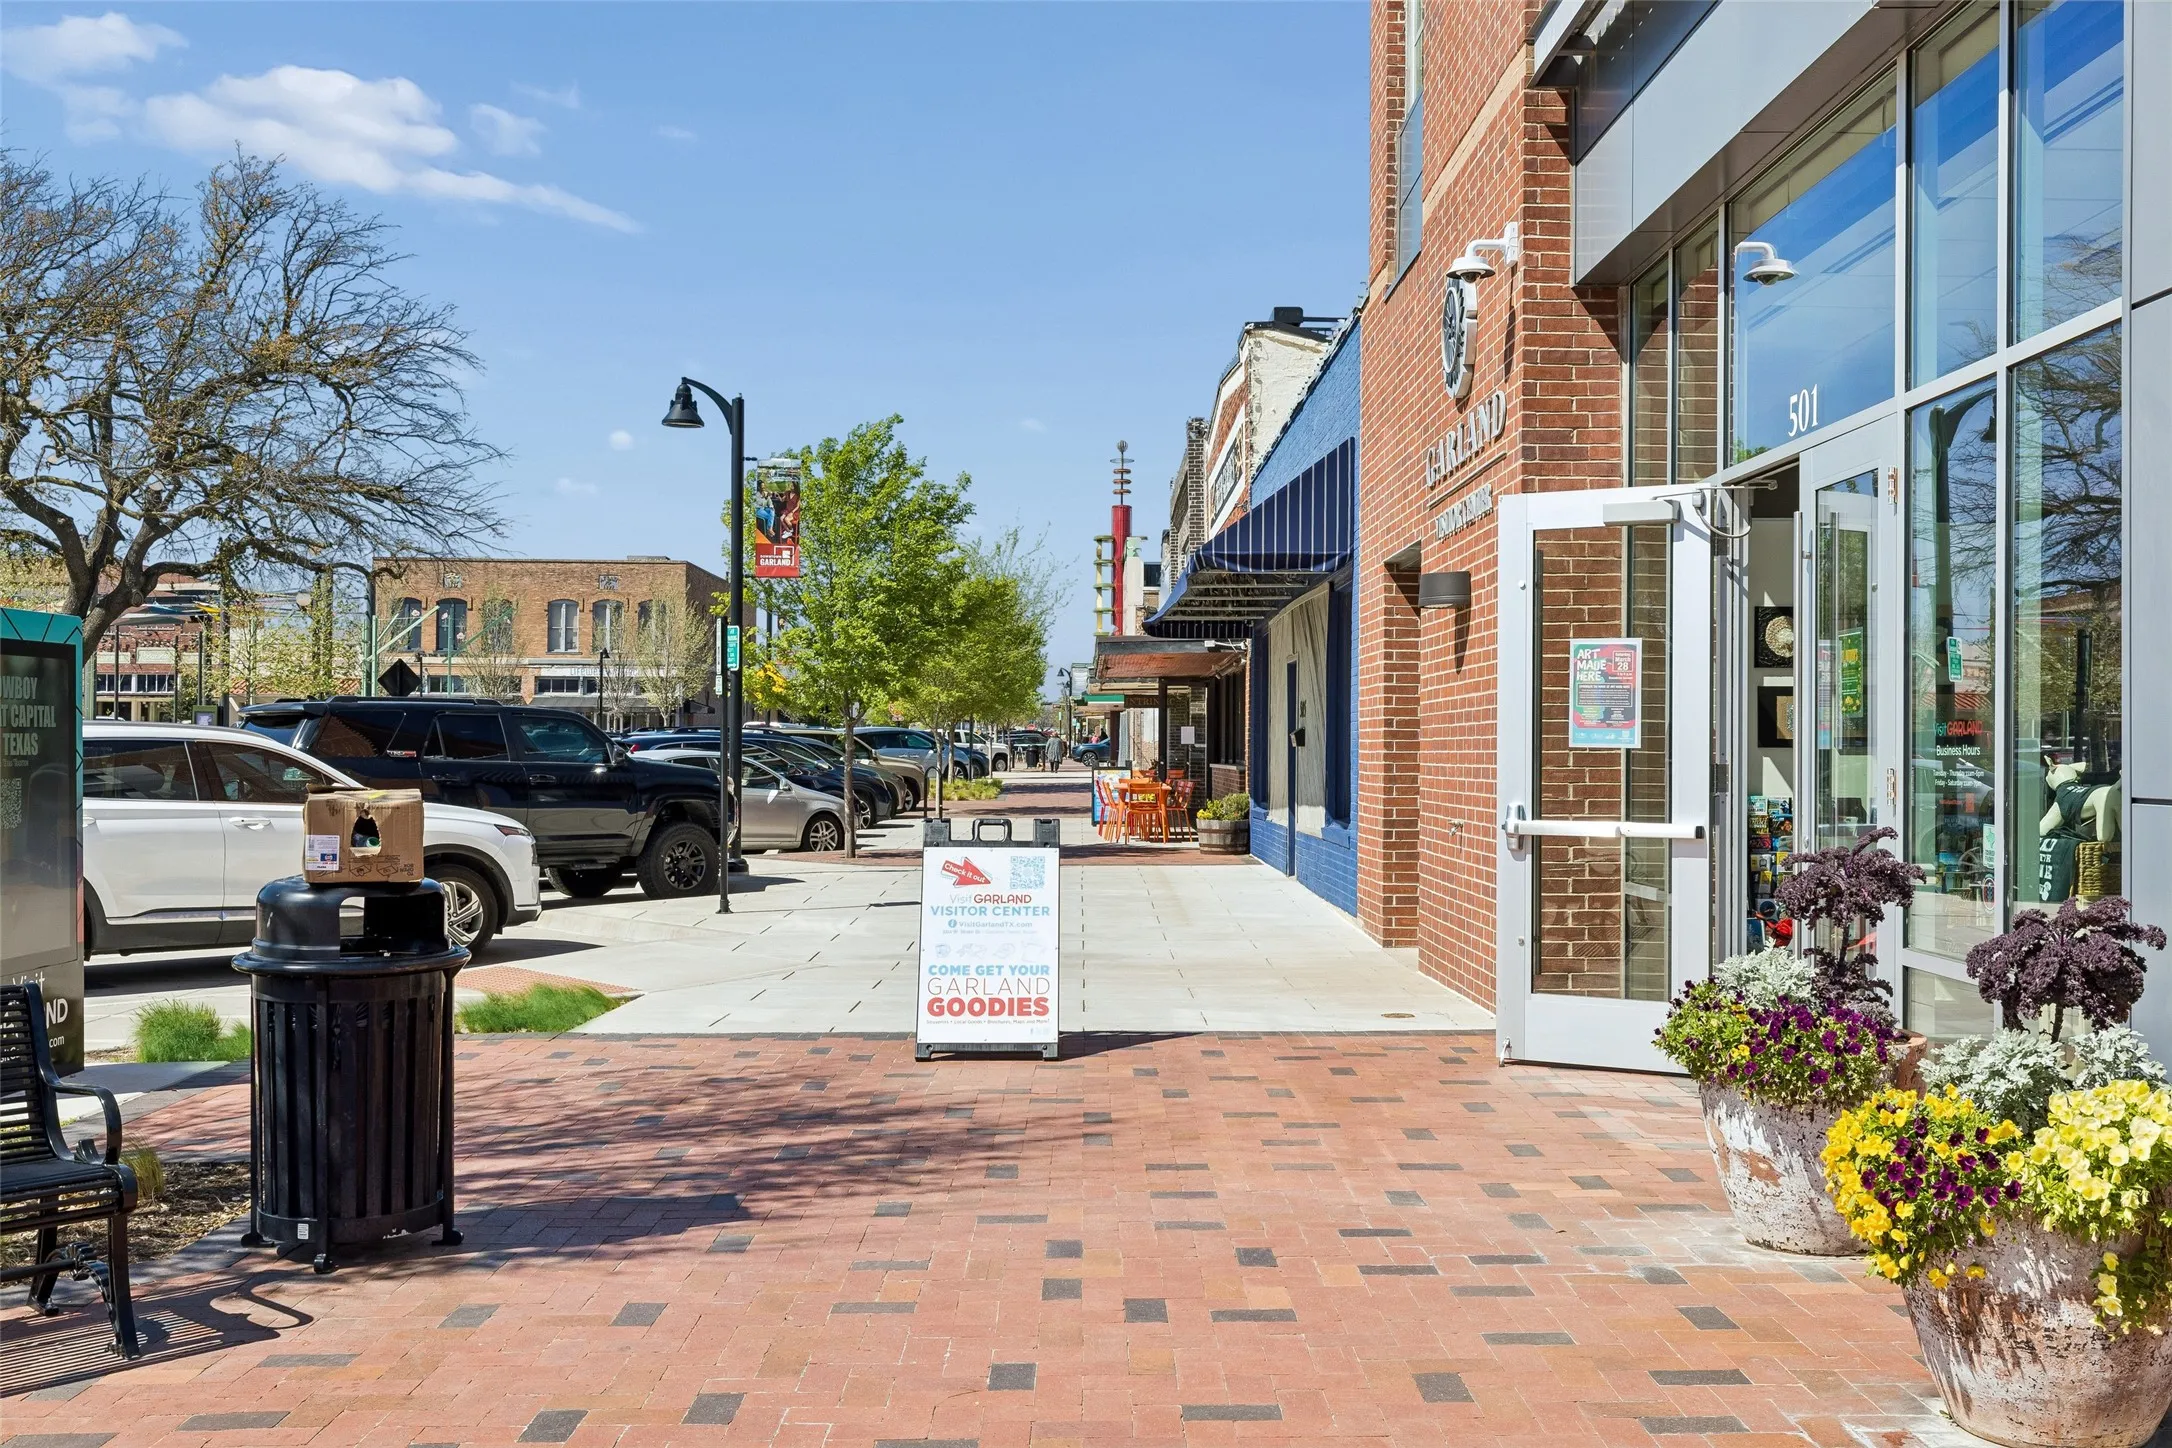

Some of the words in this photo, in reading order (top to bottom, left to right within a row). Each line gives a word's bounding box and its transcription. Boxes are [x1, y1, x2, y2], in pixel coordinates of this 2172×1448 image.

[1788, 383, 1818, 437] 501
[1426, 390, 1507, 487] GARLAND
[760, 558, 791, 566] GARLAND
[1577, 648, 1600, 660] ART
[1576, 660, 1606, 671] MADE
[1617, 662, 1629, 671] 28
[1576, 671, 1602, 681] HERE
[0, 675, 38, 700] WBOY
[11, 704, 56, 728] CAPITAL
[1933, 722, 1946, 736] Visit
[1947, 720, 1983, 736] GARLAND
[3, 733, 39, 756] TEXAS
[1936, 744, 1962, 756] Business
[1962, 744, 1981, 756] Hours
[1935, 779, 1946, 787] Friday
[944, 863, 966, 875] Check
[966, 870, 973, 878] it
[973, 874, 985, 883] out
[949, 893, 972, 904] Visit
[973, 894, 1032, 904] GARLAND
[930, 906, 987, 916] VISITOR
[992, 906, 1050, 916] CENTER
[928, 965, 970, 976] COME
[975, 965, 1004, 976] GET
[1009, 965, 1050, 976] YOUR
[927, 977, 1050, 996] GARLAND
[927, 996, 1050, 1017] GOODIES
